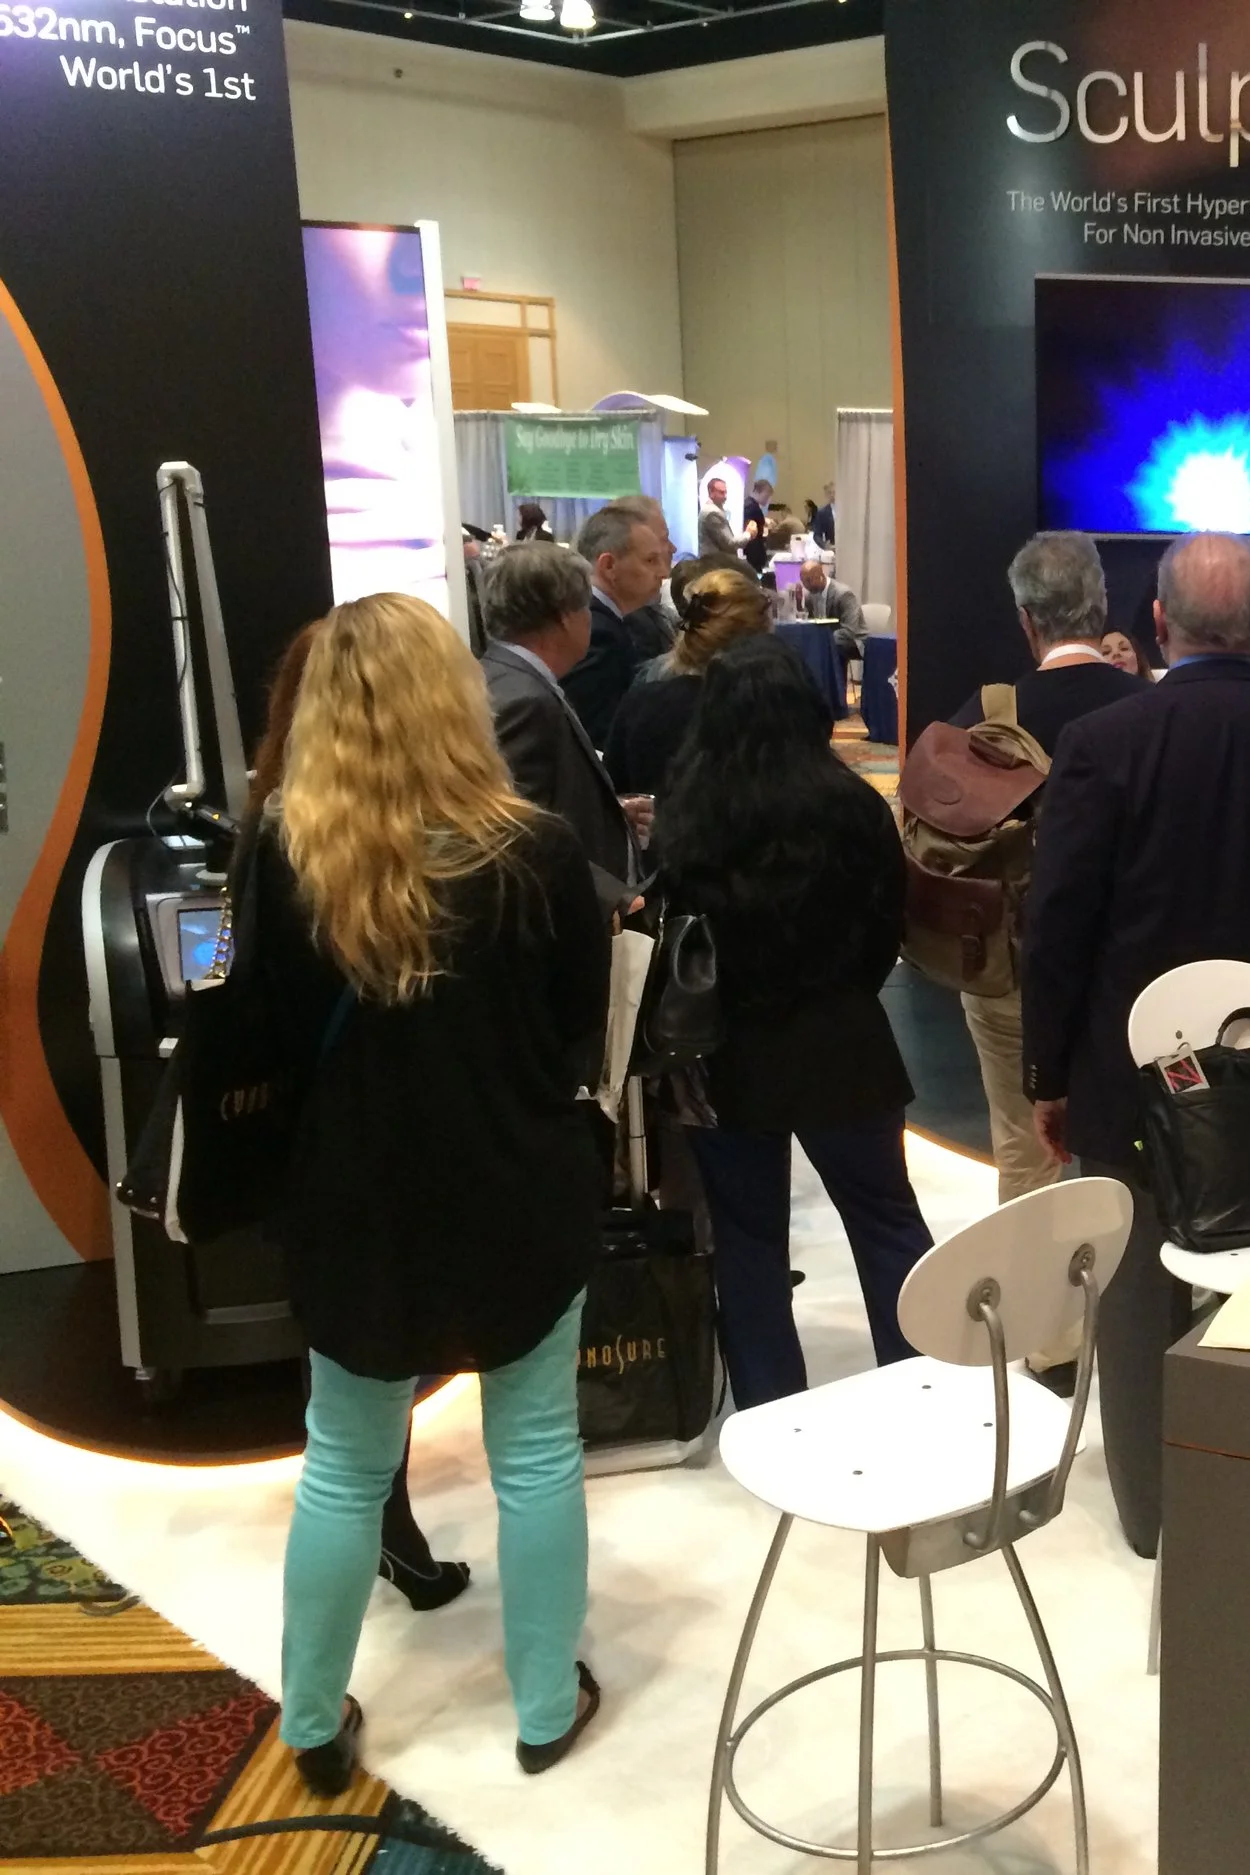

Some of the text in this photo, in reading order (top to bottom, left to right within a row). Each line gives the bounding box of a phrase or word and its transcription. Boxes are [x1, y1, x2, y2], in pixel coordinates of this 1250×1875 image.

[59, 55, 257, 101] World's 1st
[1006, 190, 1045, 213] The
[1051, 191, 1128, 213] World's
[1134, 192, 1181, 214] First
[1084, 222, 1117, 245] For
[1123, 223, 1165, 245] Non
